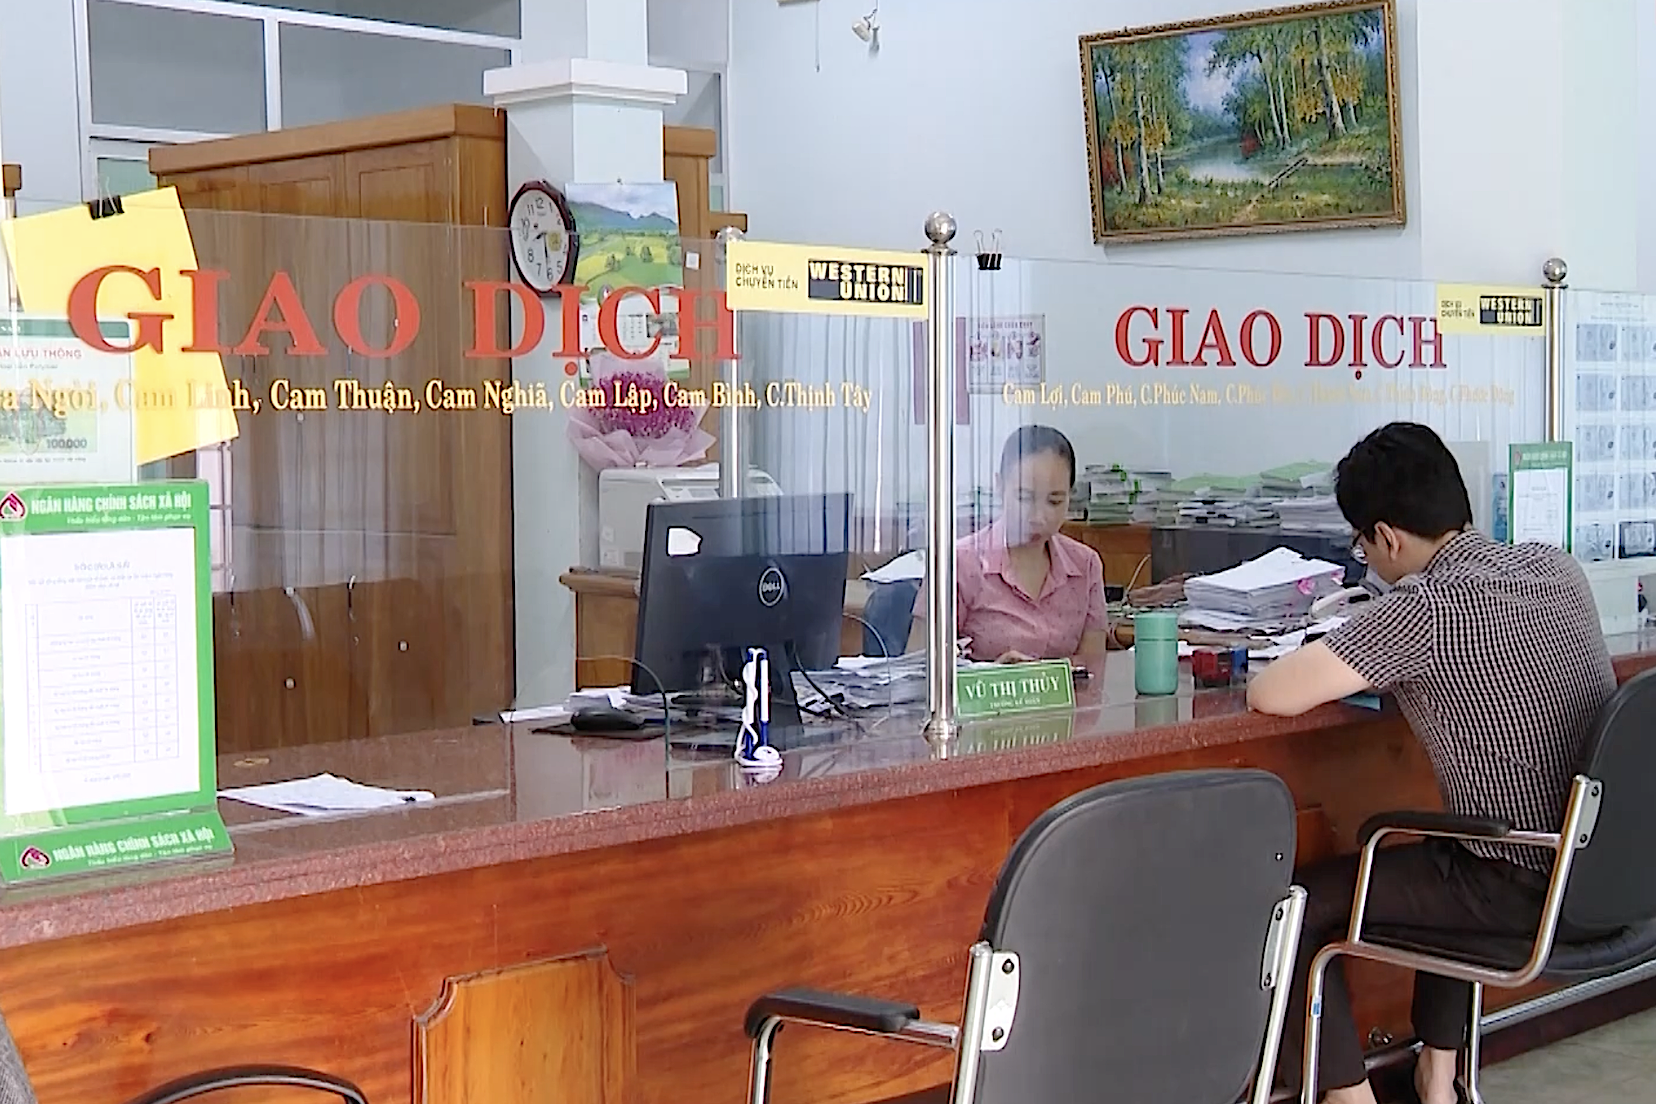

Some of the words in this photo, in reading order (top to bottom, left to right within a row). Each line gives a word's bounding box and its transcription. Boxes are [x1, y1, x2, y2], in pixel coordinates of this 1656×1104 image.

[810, 261, 904, 285] WESTERN
[840, 280, 904, 302] UNION
[1481, 297, 1532, 311] WESTERN
[67, 264, 421, 358] GIAO
[464, 281, 741, 376] DỊCH
[1497, 310, 1532, 325] UNION
[1115, 305, 1283, 367] GIAO
[1304, 312, 1447, 380] DỊCH
[270, 379, 327, 411] Cam
[333, 380, 420, 414] Thuận,
[425, 379, 476, 411] Cam
[559, 382, 606, 409] Cam
[613, 380, 658, 413] Lập,
[663, 382, 706, 409] Cam
[711, 380, 762, 410] Bình,
[841, 382, 873, 413] Tây
[1003, 383, 1036, 405] Cam
[1040, 382, 1068, 411] Lợi,
[1071, 383, 1101, 405] Cam
[1106, 383, 1137, 408] Phú,
[31, 495, 62, 515] NGÂN
[63, 495, 94, 513] HÀNG
[95, 493, 127, 512] CHÍNH
[128, 491, 157, 510] SÁCH
[174, 490, 192, 511] HỘI
[990, 680, 1017, 698] THỊ
[1019, 671, 1060, 693] THỦY
